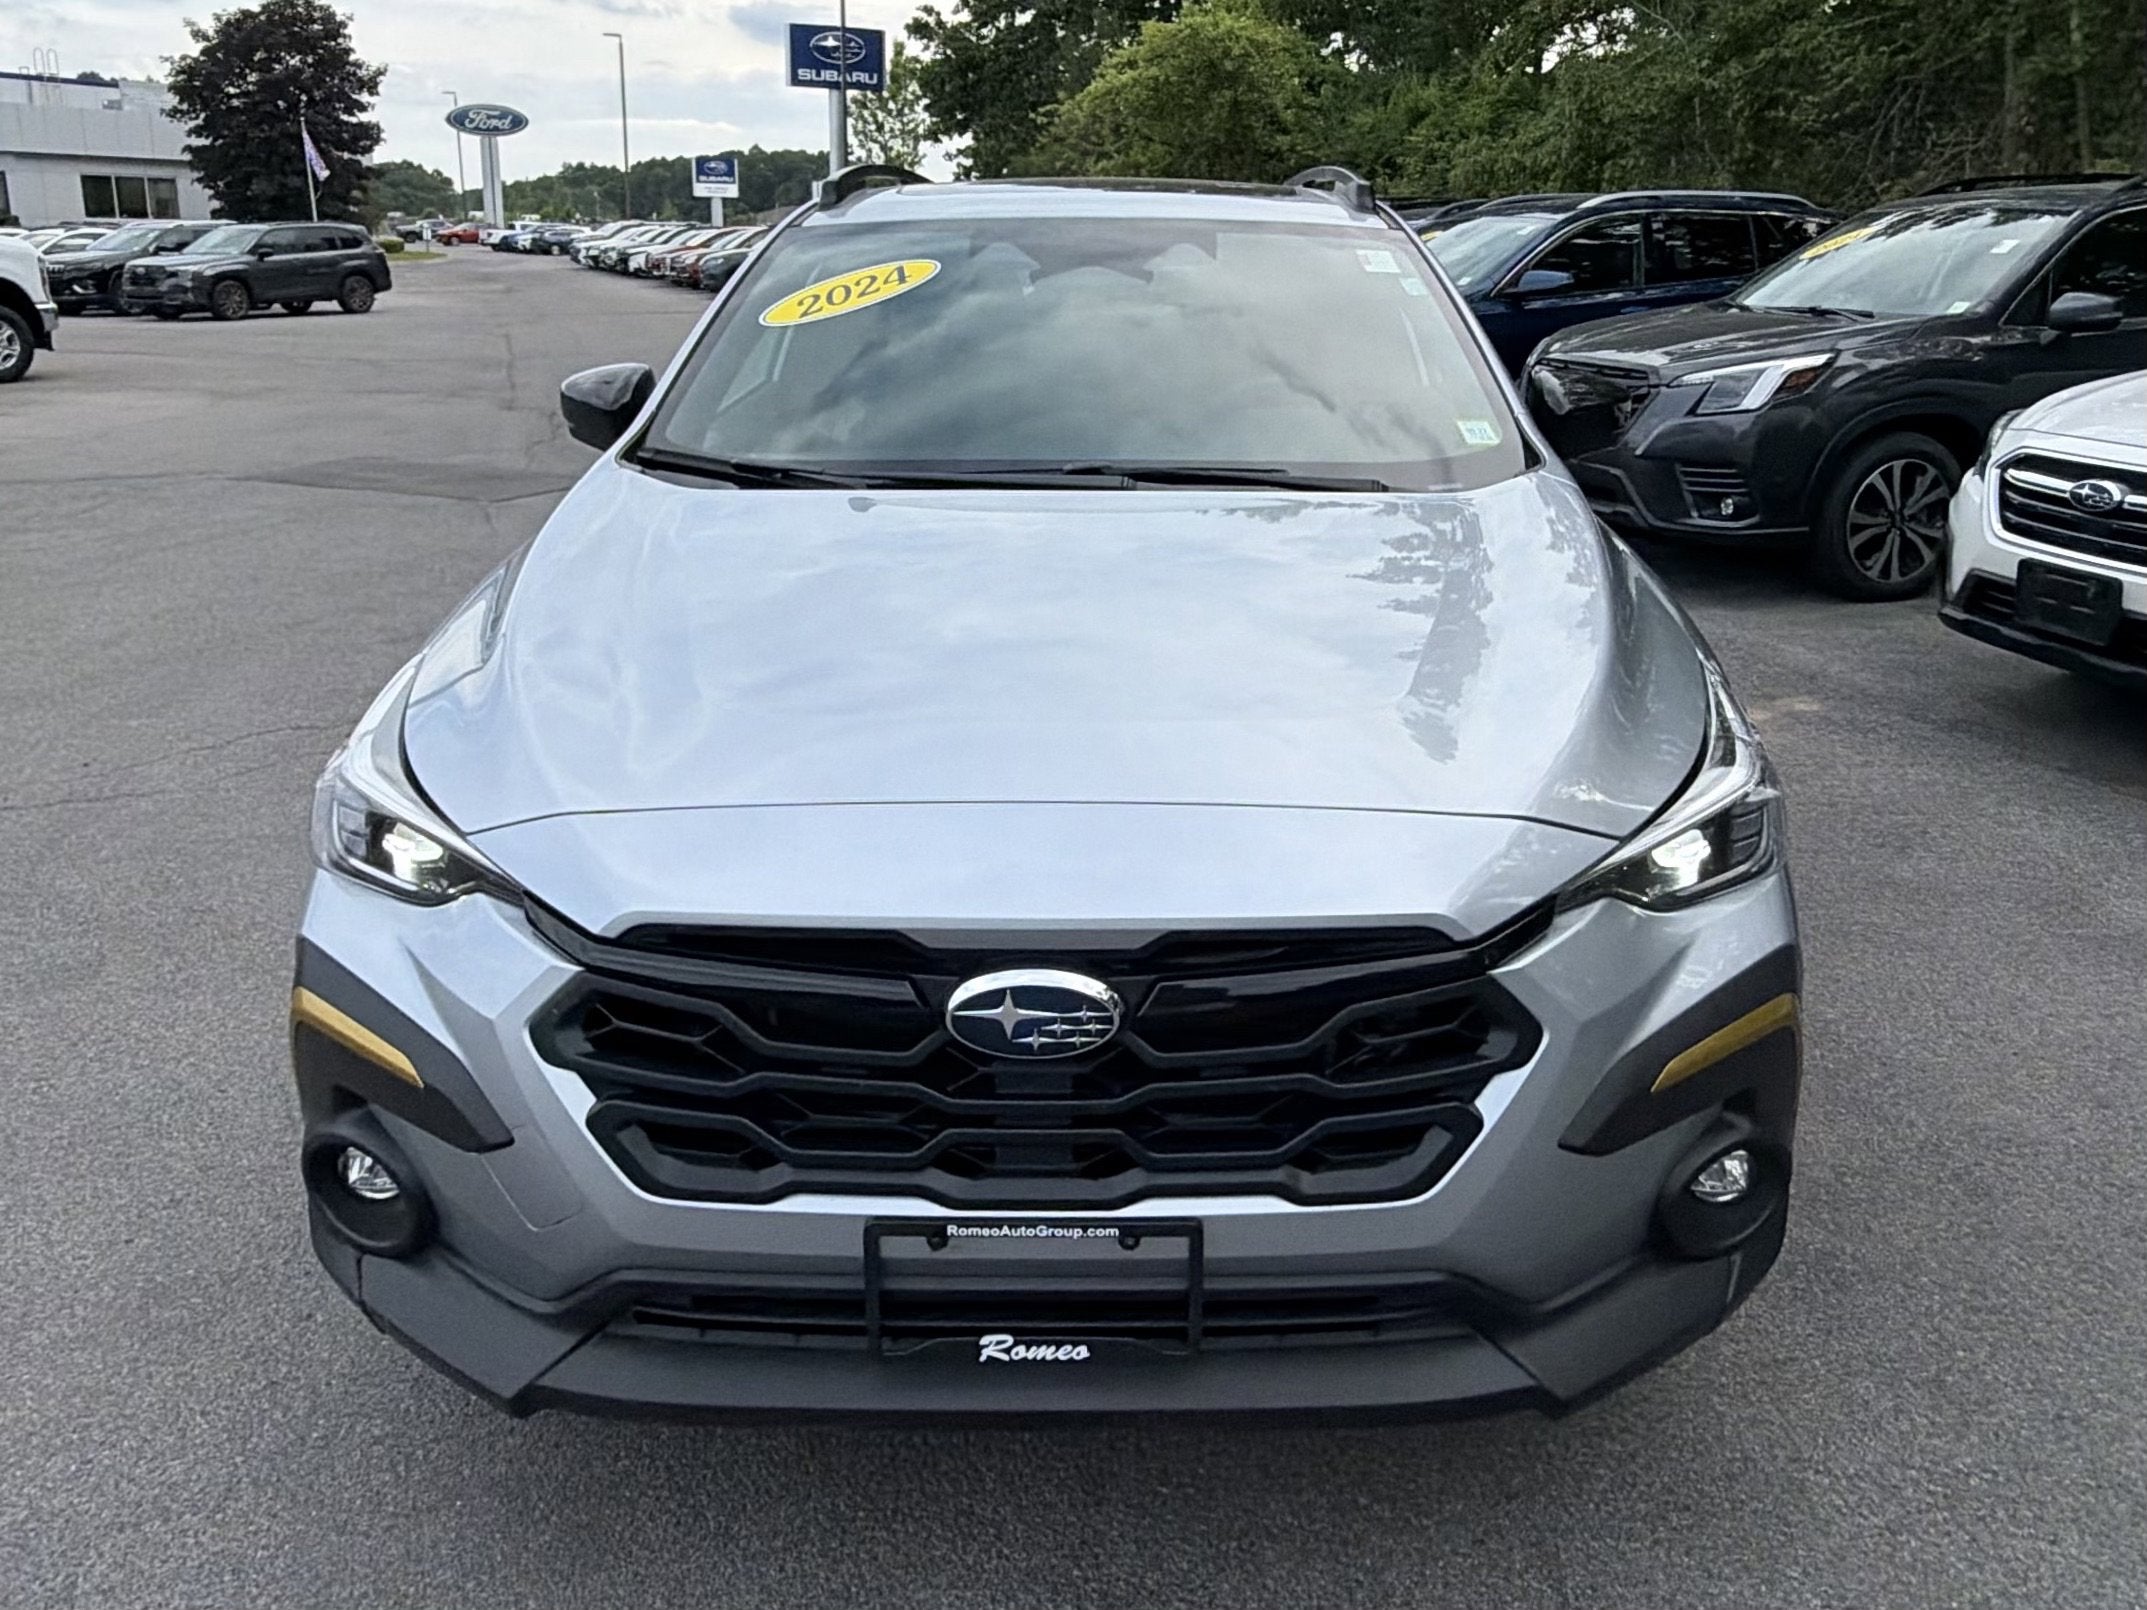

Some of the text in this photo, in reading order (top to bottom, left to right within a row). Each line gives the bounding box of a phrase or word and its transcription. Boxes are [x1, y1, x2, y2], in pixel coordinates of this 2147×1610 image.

[797, 67, 878, 84] SUBARU
[464, 109, 513, 130] Ford
[797, 265, 911, 319] 2024
[946, 1225, 1119, 1239] RomeoAutoGroup.com
[979, 1334, 1090, 1362] Romeo
